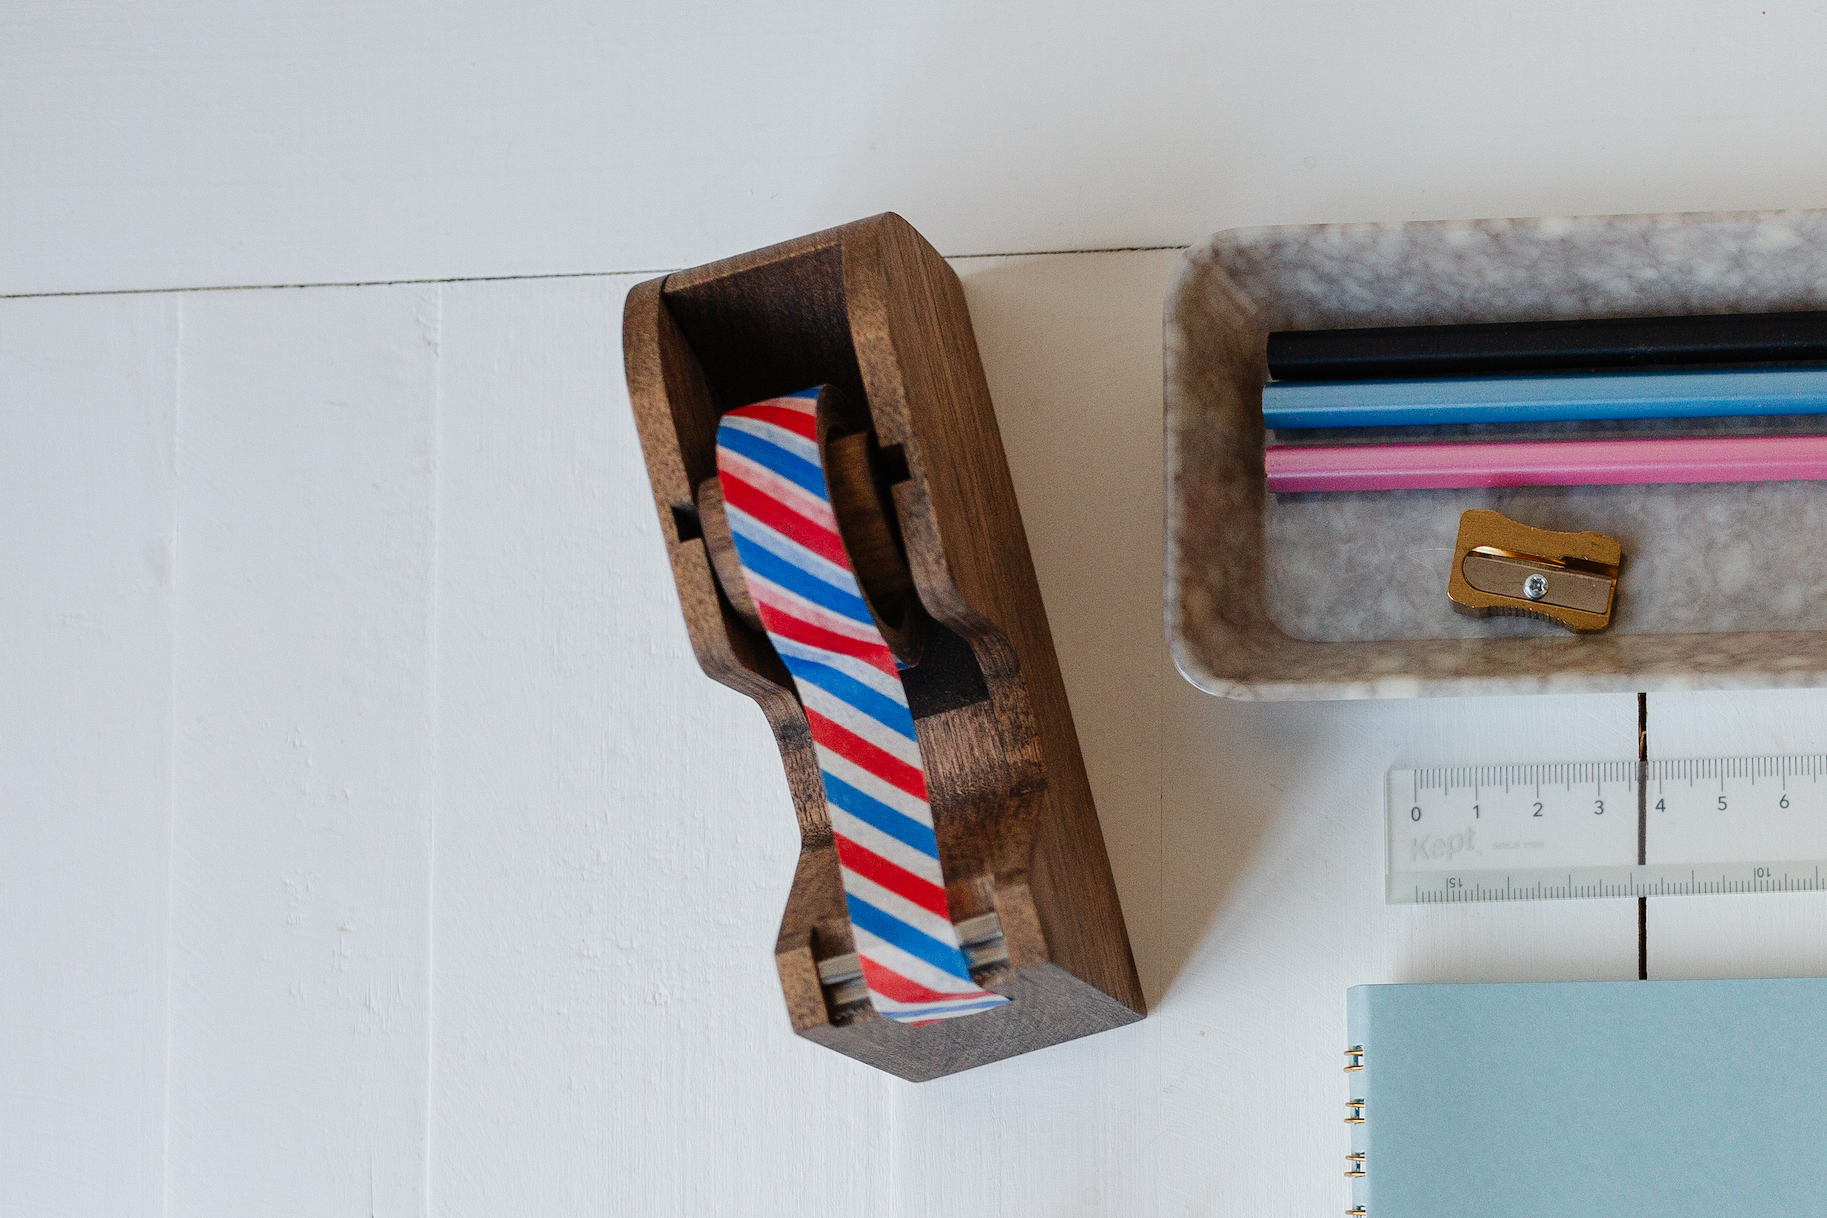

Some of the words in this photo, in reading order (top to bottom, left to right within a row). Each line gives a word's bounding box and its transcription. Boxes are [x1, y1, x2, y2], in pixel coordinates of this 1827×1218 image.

[1411, 806, 1422, 822] 0
[1473, 804, 1479, 819] 1
[1533, 802, 1543, 817] 2
[1594, 800, 1604, 815] 3
[1655, 798, 1666, 812] 4
[1718, 796, 1727, 811] 5
[1779, 794, 1789, 809] 6
